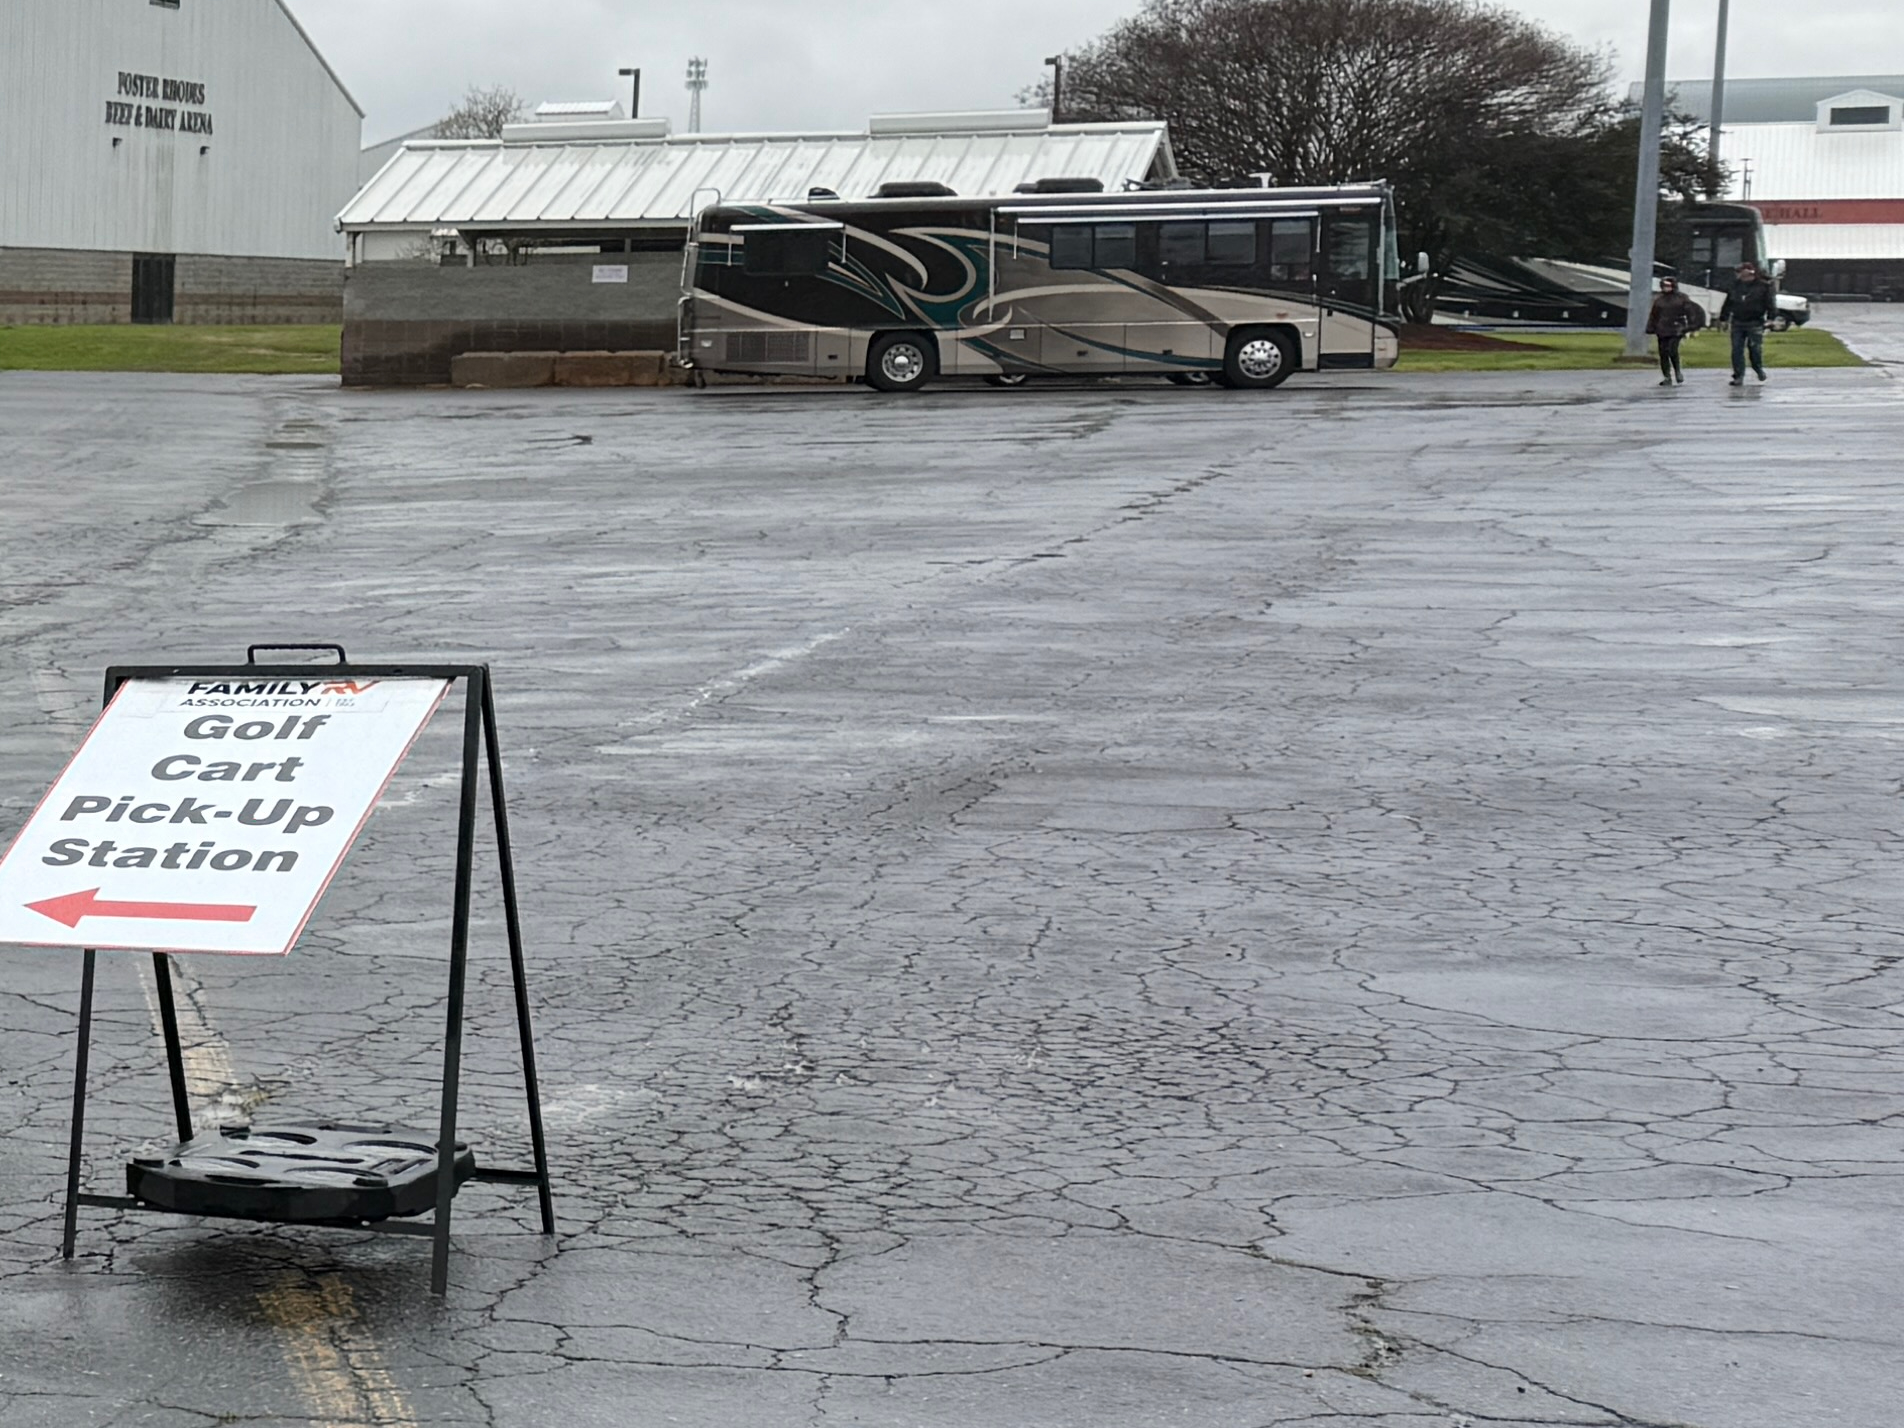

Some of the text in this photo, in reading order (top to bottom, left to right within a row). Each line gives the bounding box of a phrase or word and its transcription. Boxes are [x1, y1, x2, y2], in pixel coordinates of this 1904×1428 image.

[117, 71, 205, 105] FOSTER RHODES
[105, 100, 213, 135] BEEF & DAIRY ARENA
[179, 698, 322, 708] ASSOCIATION
[183, 714, 332, 740] Golf
[151, 754, 304, 782] Cart
[59, 795, 335, 834] Pick-Up
[42, 838, 299, 872] Station
